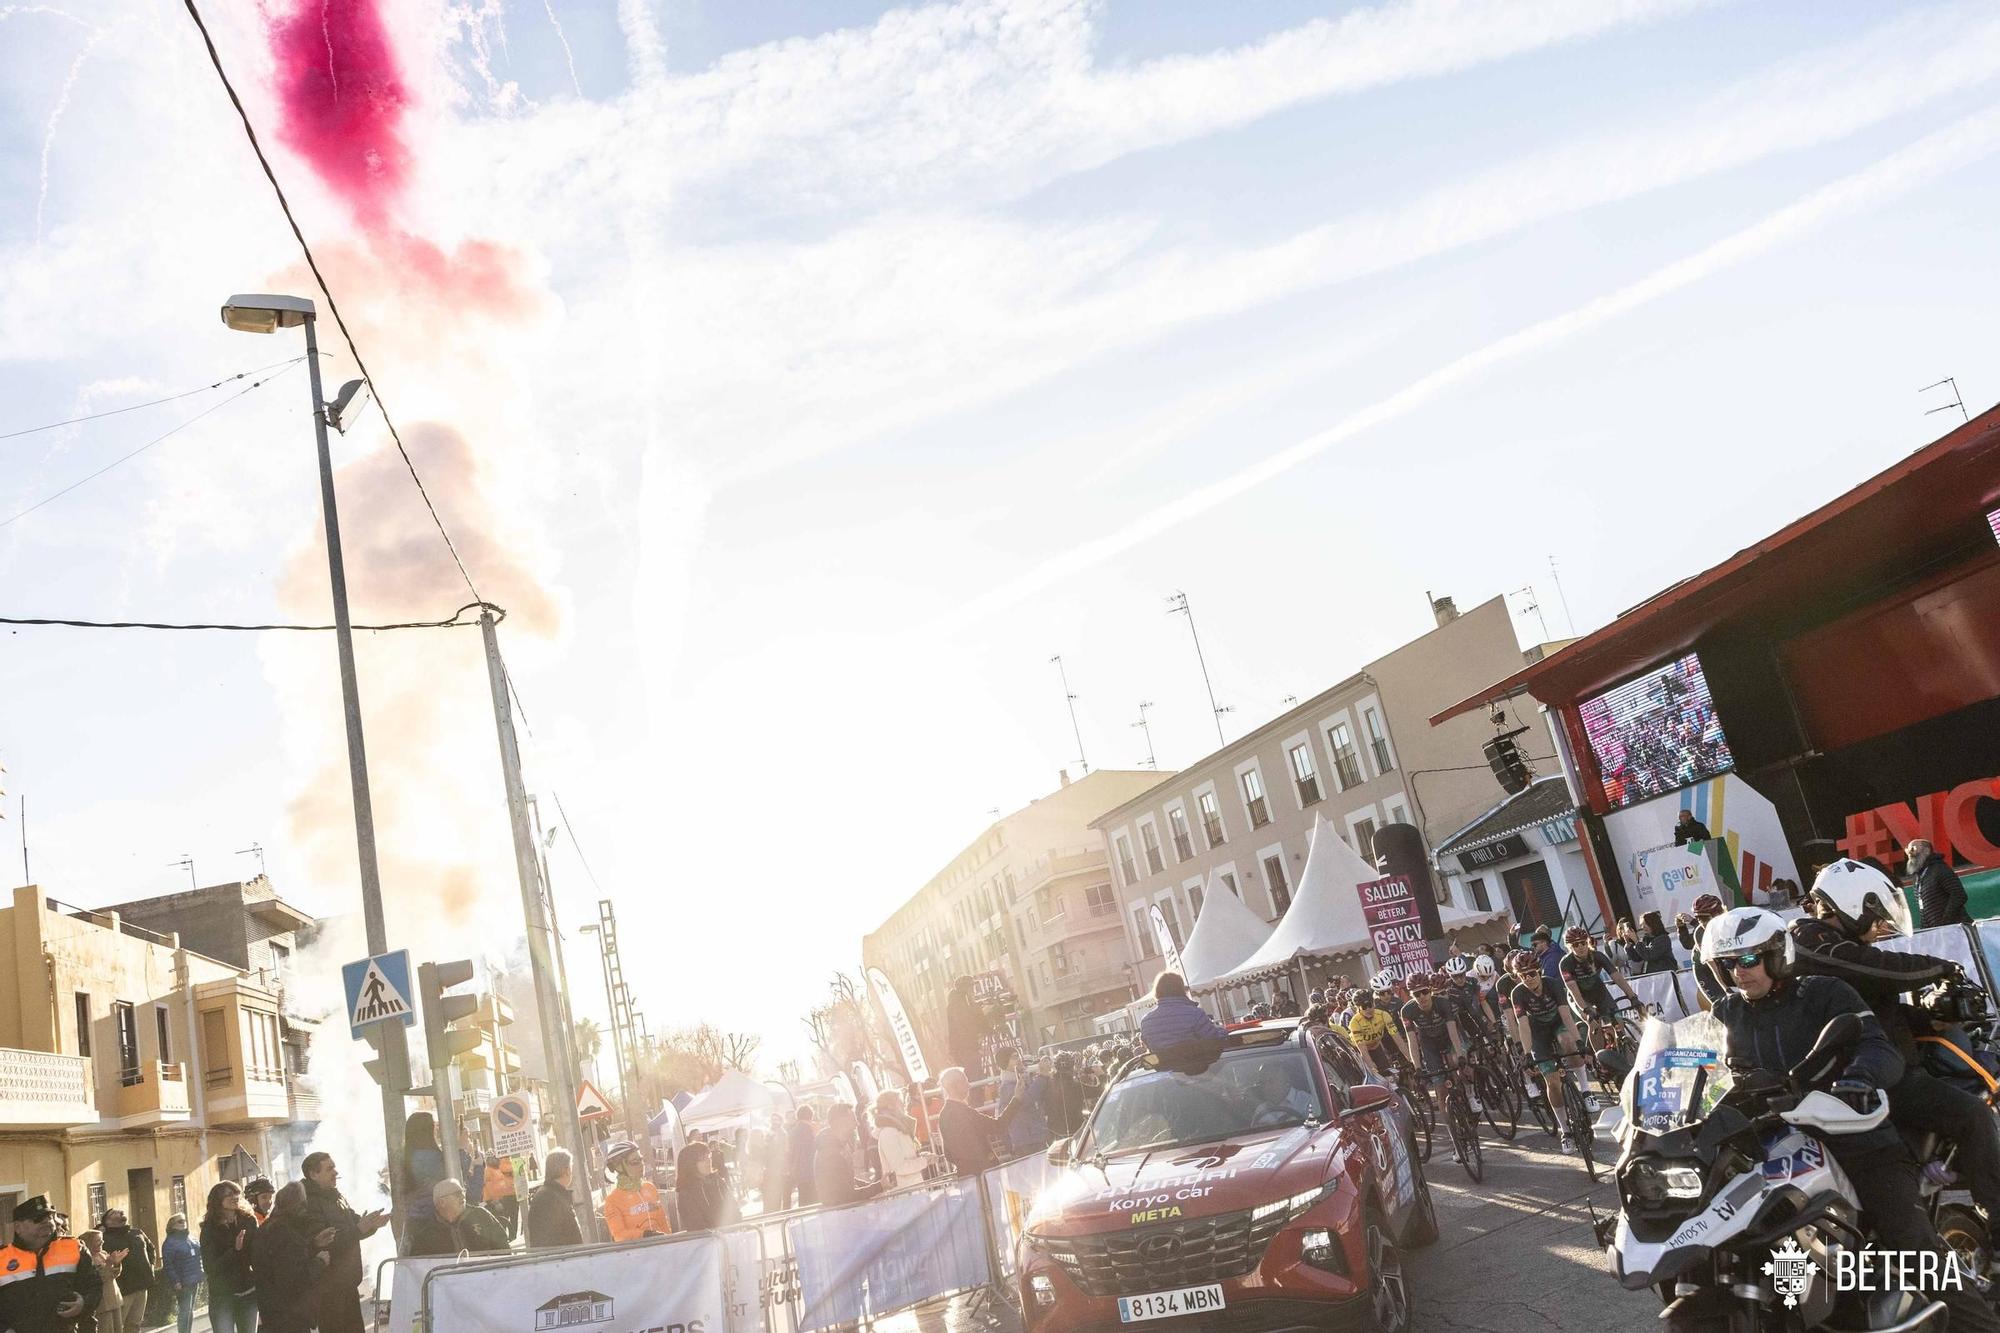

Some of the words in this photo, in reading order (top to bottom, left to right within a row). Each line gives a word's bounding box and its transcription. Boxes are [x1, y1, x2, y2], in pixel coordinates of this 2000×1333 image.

[1364, 881, 1408, 902] SALIDA
[1378, 906, 1407, 920] BÉTERA
[1399, 940, 1427, 952] FEMINAS
[1380, 954, 1401, 966] GRAN
[1401, 948, 1429, 962] PREMIO
[1642, 1077, 1658, 1099] R
[1643, 1114, 1668, 1127] MOTOS
[1096, 1168, 1237, 1201] HYUNDAI
[1109, 1194, 1168, 1213] Koryo
[1175, 1186, 1214, 1200] Car
[1131, 1206, 1182, 1224] META
[1669, 1228, 1700, 1249] MOTOS
[1695, 1220, 1709, 1234] TV
[1132, 1294, 1178, 1317] 8134
[1183, 1288, 1221, 1310] MBN
